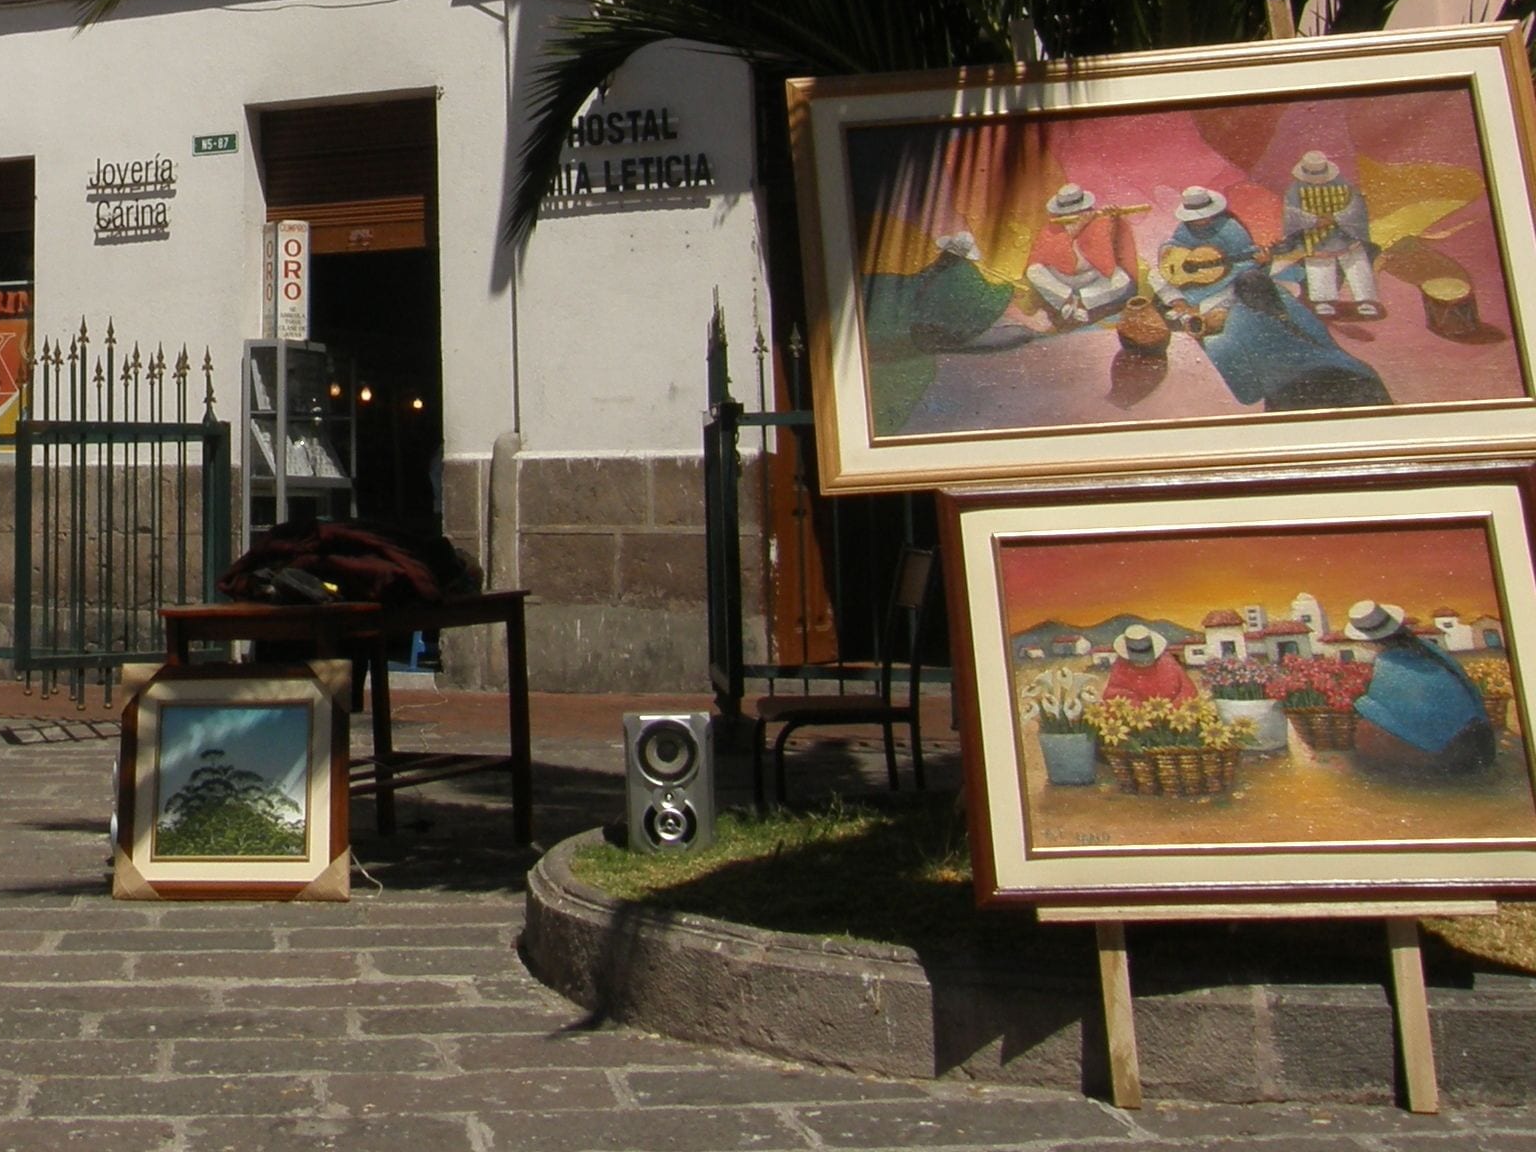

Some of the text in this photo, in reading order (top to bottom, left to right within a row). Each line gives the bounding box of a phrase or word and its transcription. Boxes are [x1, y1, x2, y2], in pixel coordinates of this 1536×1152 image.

[567, 108, 678, 148] HOSTAL
[89, 152, 175, 192] Joyería
[604, 152, 712, 193] LETICIA
[284, 238, 302, 301] ORO
